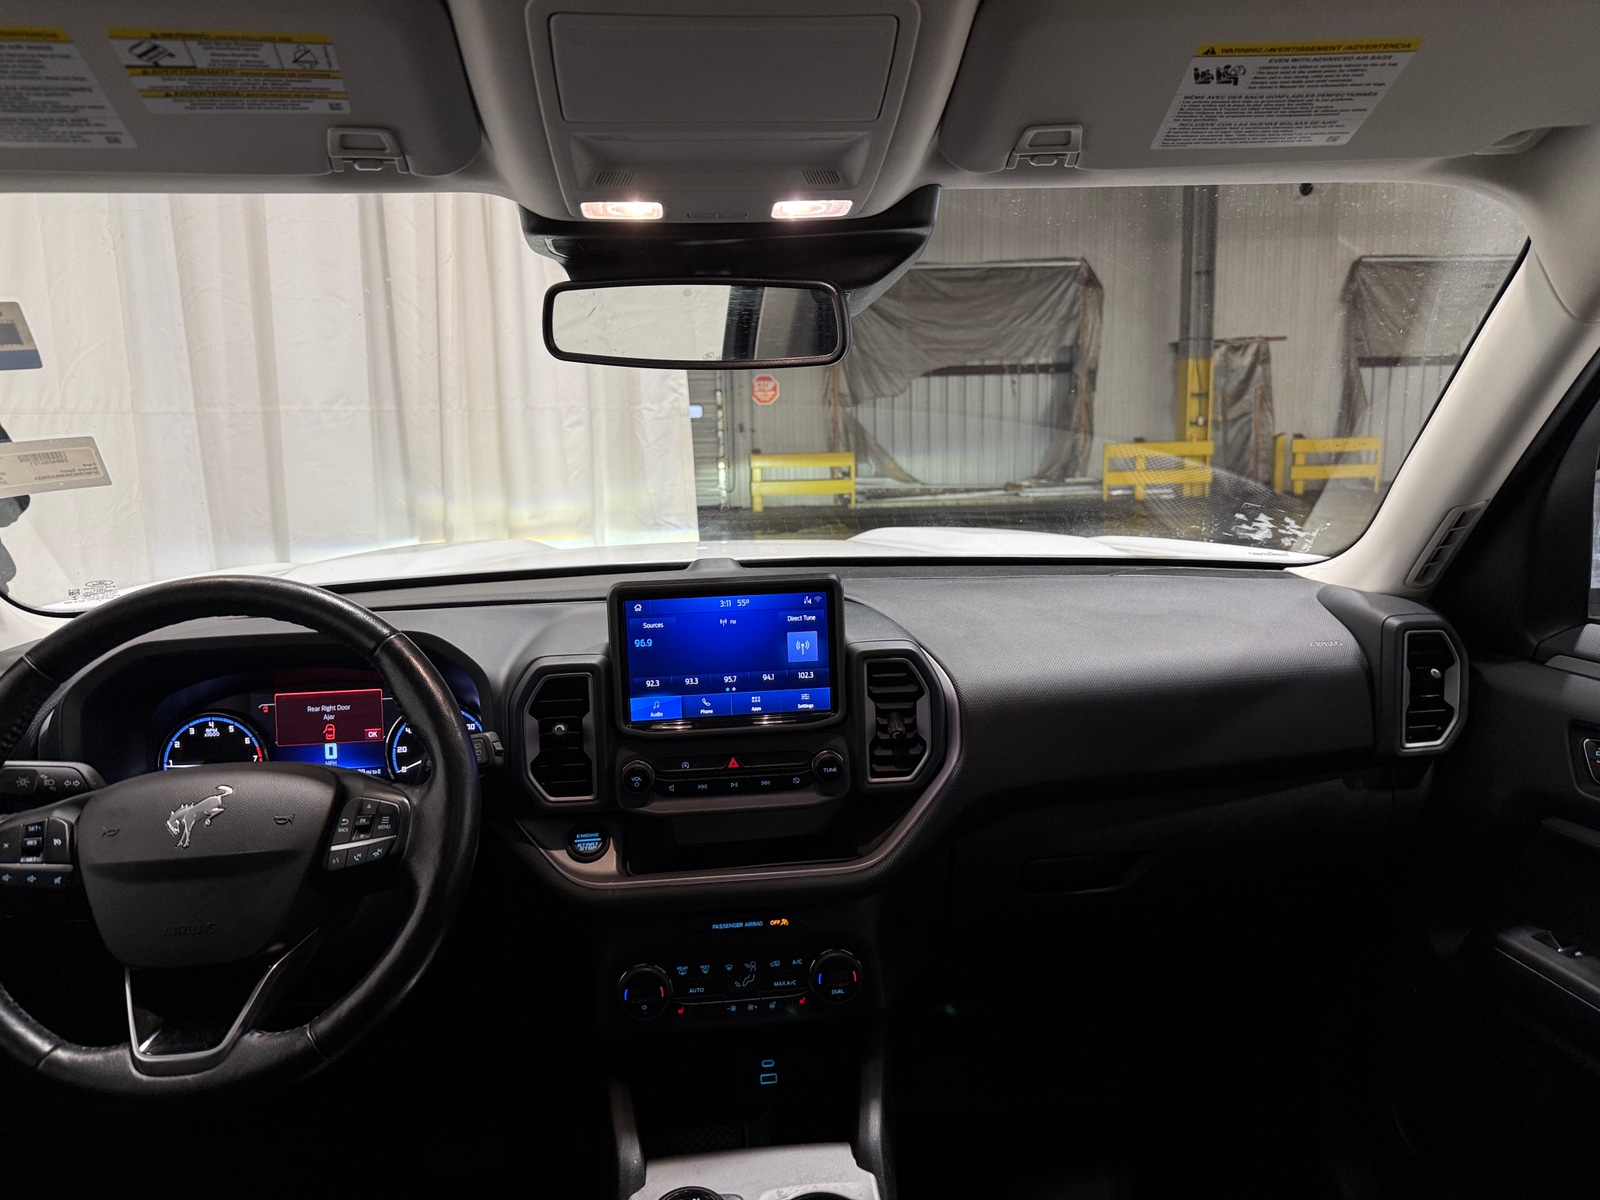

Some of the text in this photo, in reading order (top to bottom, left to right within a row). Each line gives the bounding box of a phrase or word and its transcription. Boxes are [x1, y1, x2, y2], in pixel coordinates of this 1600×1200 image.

[753, 381, 776, 392] STOP
[634, 639, 653, 648] 96.9
[762, 673, 775, 681] 94.1
[797, 671, 814, 680] 102.3
[321, 705, 336, 713] Right
[228, 725, 234, 733] 5
[244, 737, 251, 745] 6
[324, 742, 338, 760] 0
[164, 921, 217, 937] AIRBAG
[791, 958, 803, 966] A/C
